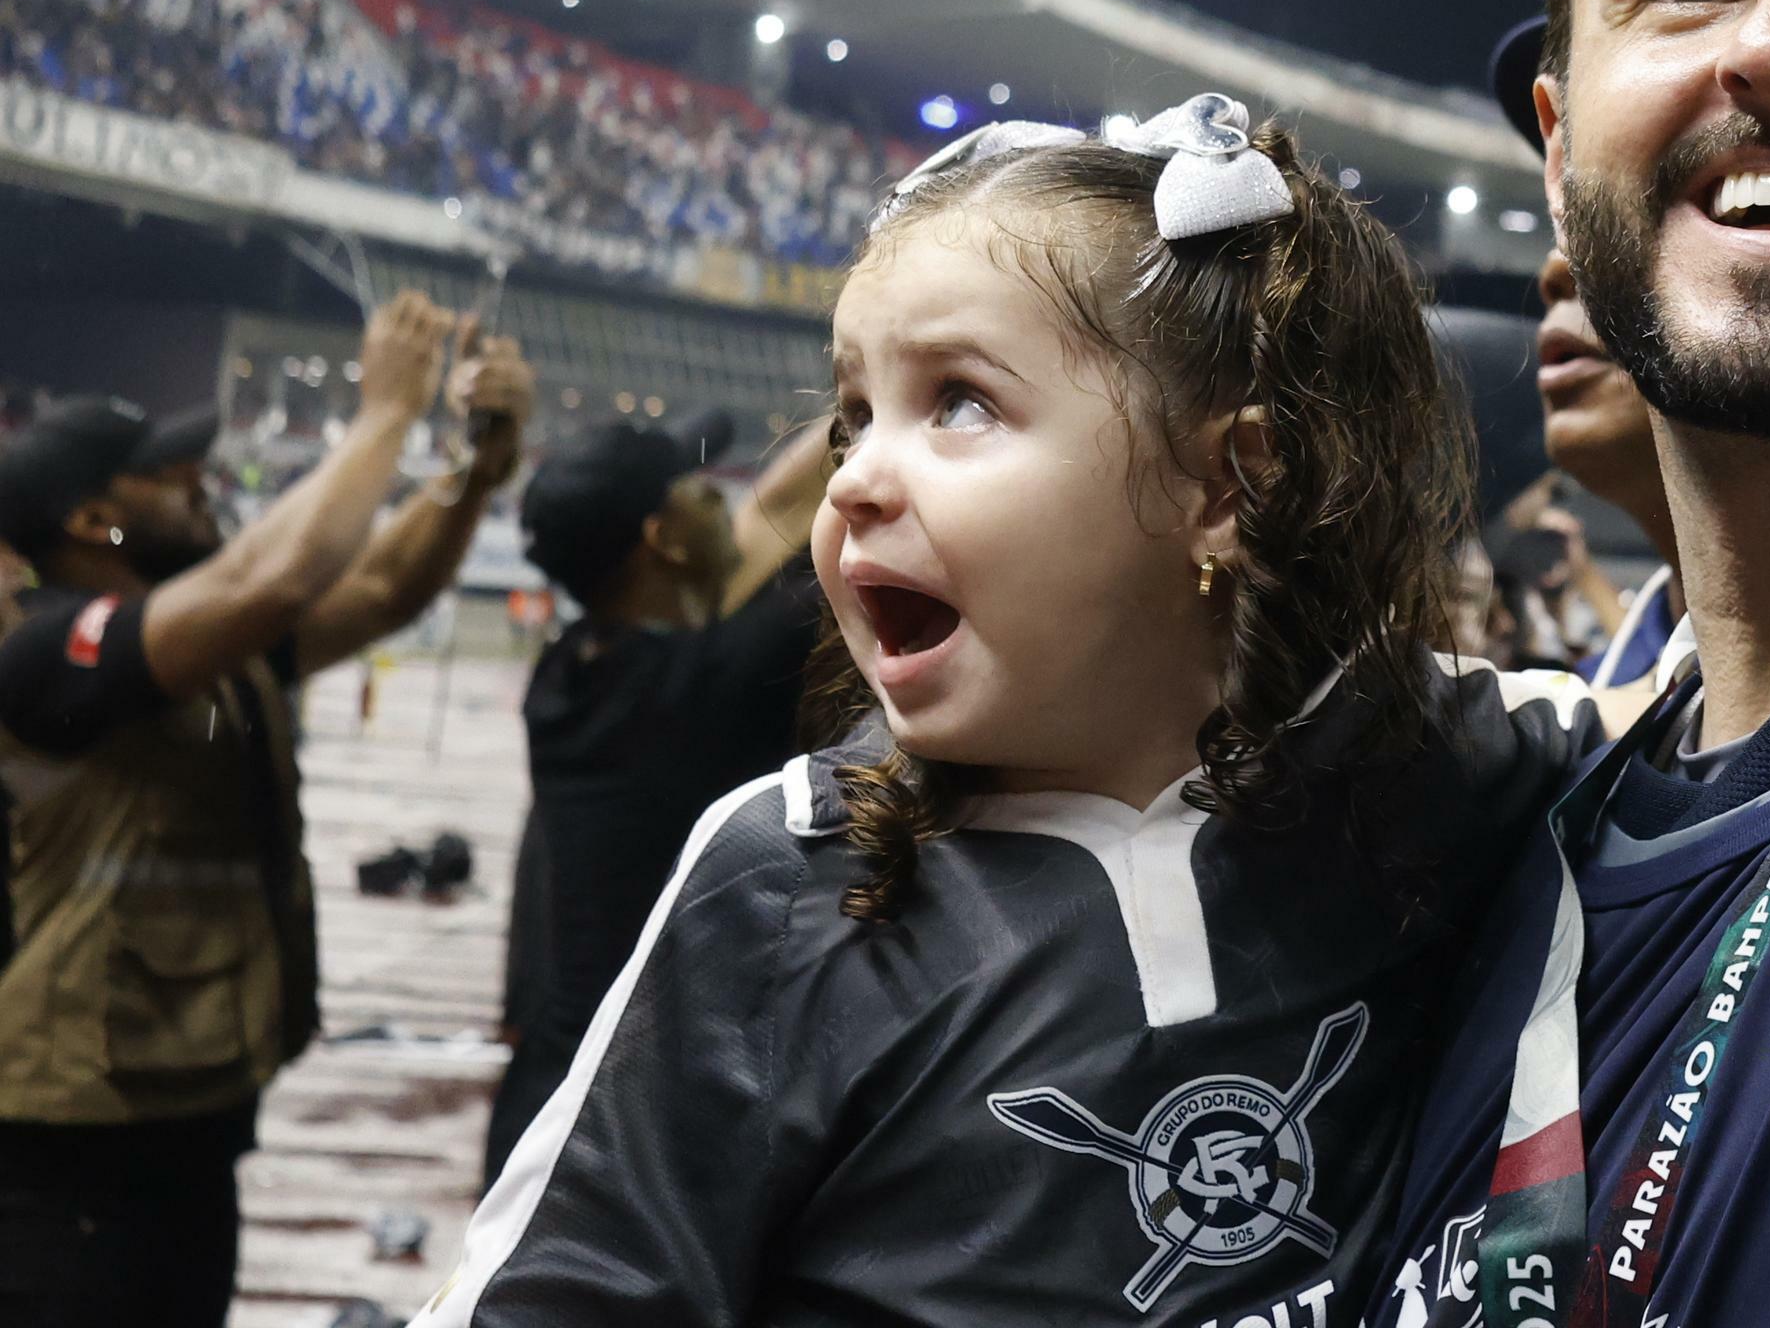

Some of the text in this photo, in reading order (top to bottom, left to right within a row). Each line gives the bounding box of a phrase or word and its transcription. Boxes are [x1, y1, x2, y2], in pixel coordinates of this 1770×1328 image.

[1157, 1092, 1271, 1147] GRUPO DO REMO
[1609, 1040, 1715, 1282] PARAZÃO
[1220, 1226, 1256, 1248] 1905
